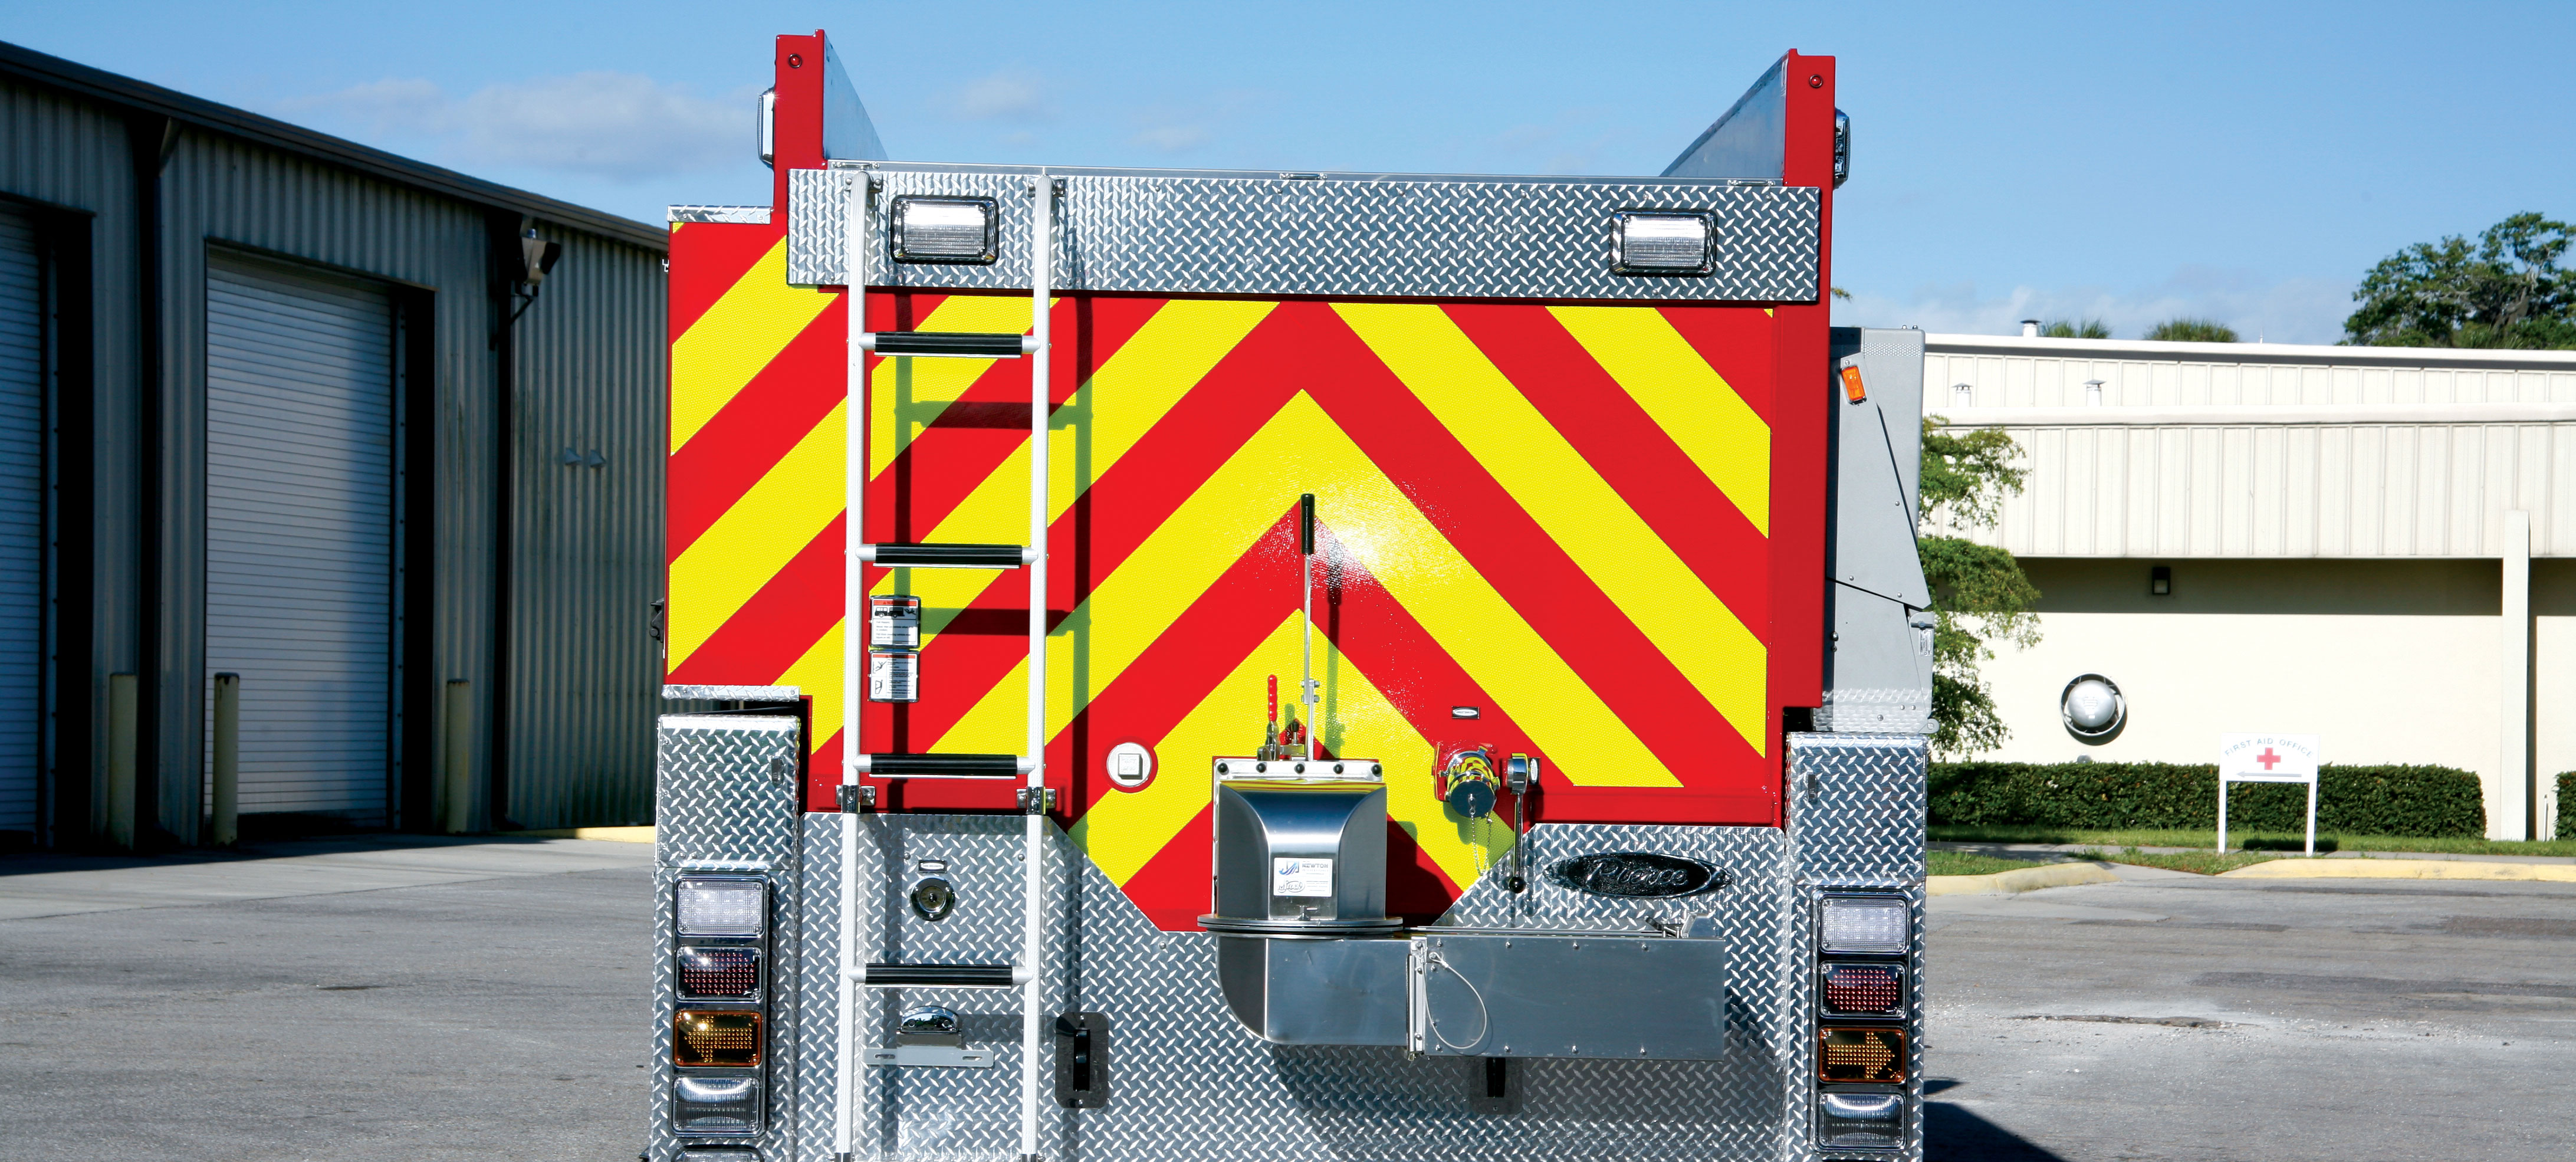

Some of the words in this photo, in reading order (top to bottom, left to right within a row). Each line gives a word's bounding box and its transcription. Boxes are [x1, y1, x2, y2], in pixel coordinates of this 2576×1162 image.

[2225, 740, 2252, 757] FIRST
[2279, 739, 2314, 758] OFFICE
[1585, 858, 1689, 886] Pierce
